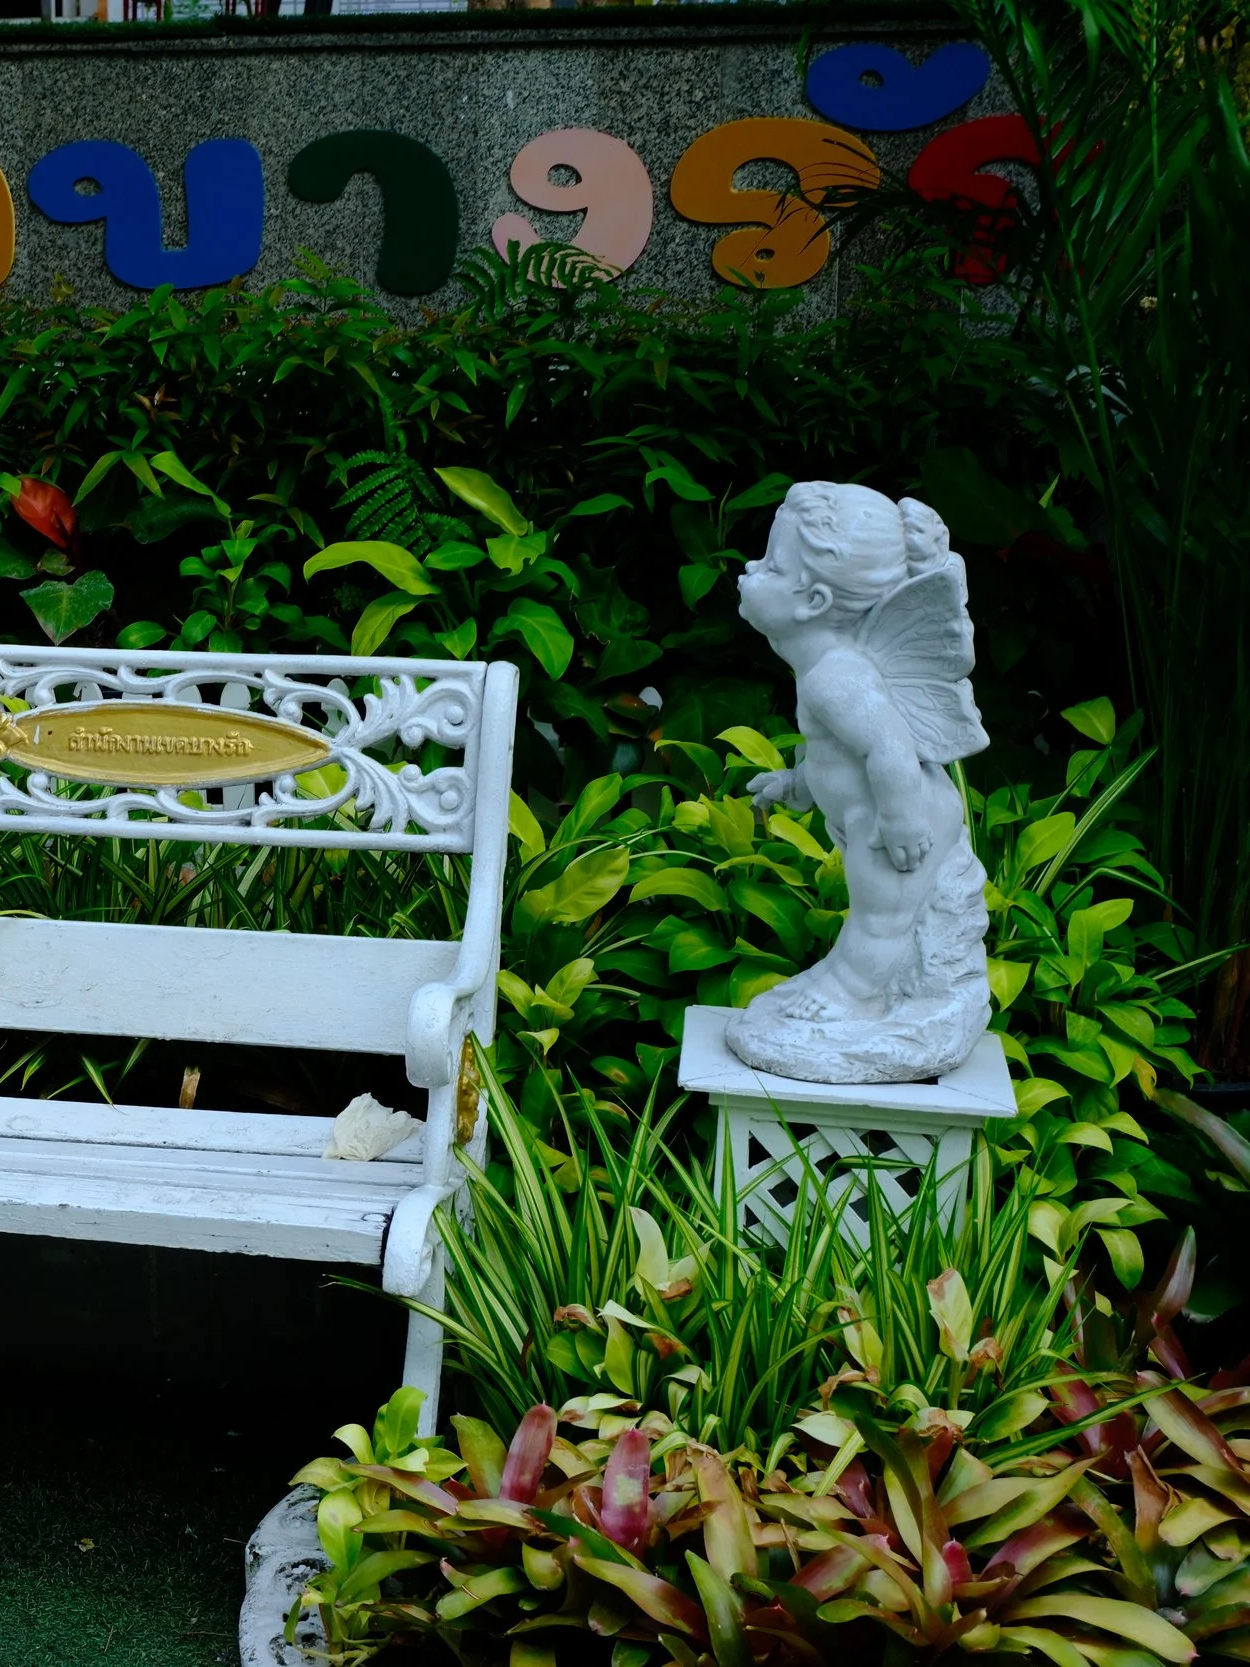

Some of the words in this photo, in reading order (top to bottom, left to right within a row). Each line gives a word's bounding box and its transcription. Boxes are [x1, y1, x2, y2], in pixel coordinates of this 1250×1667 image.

[67, 725, 255, 757] สำนักงานเขตบางรัก
